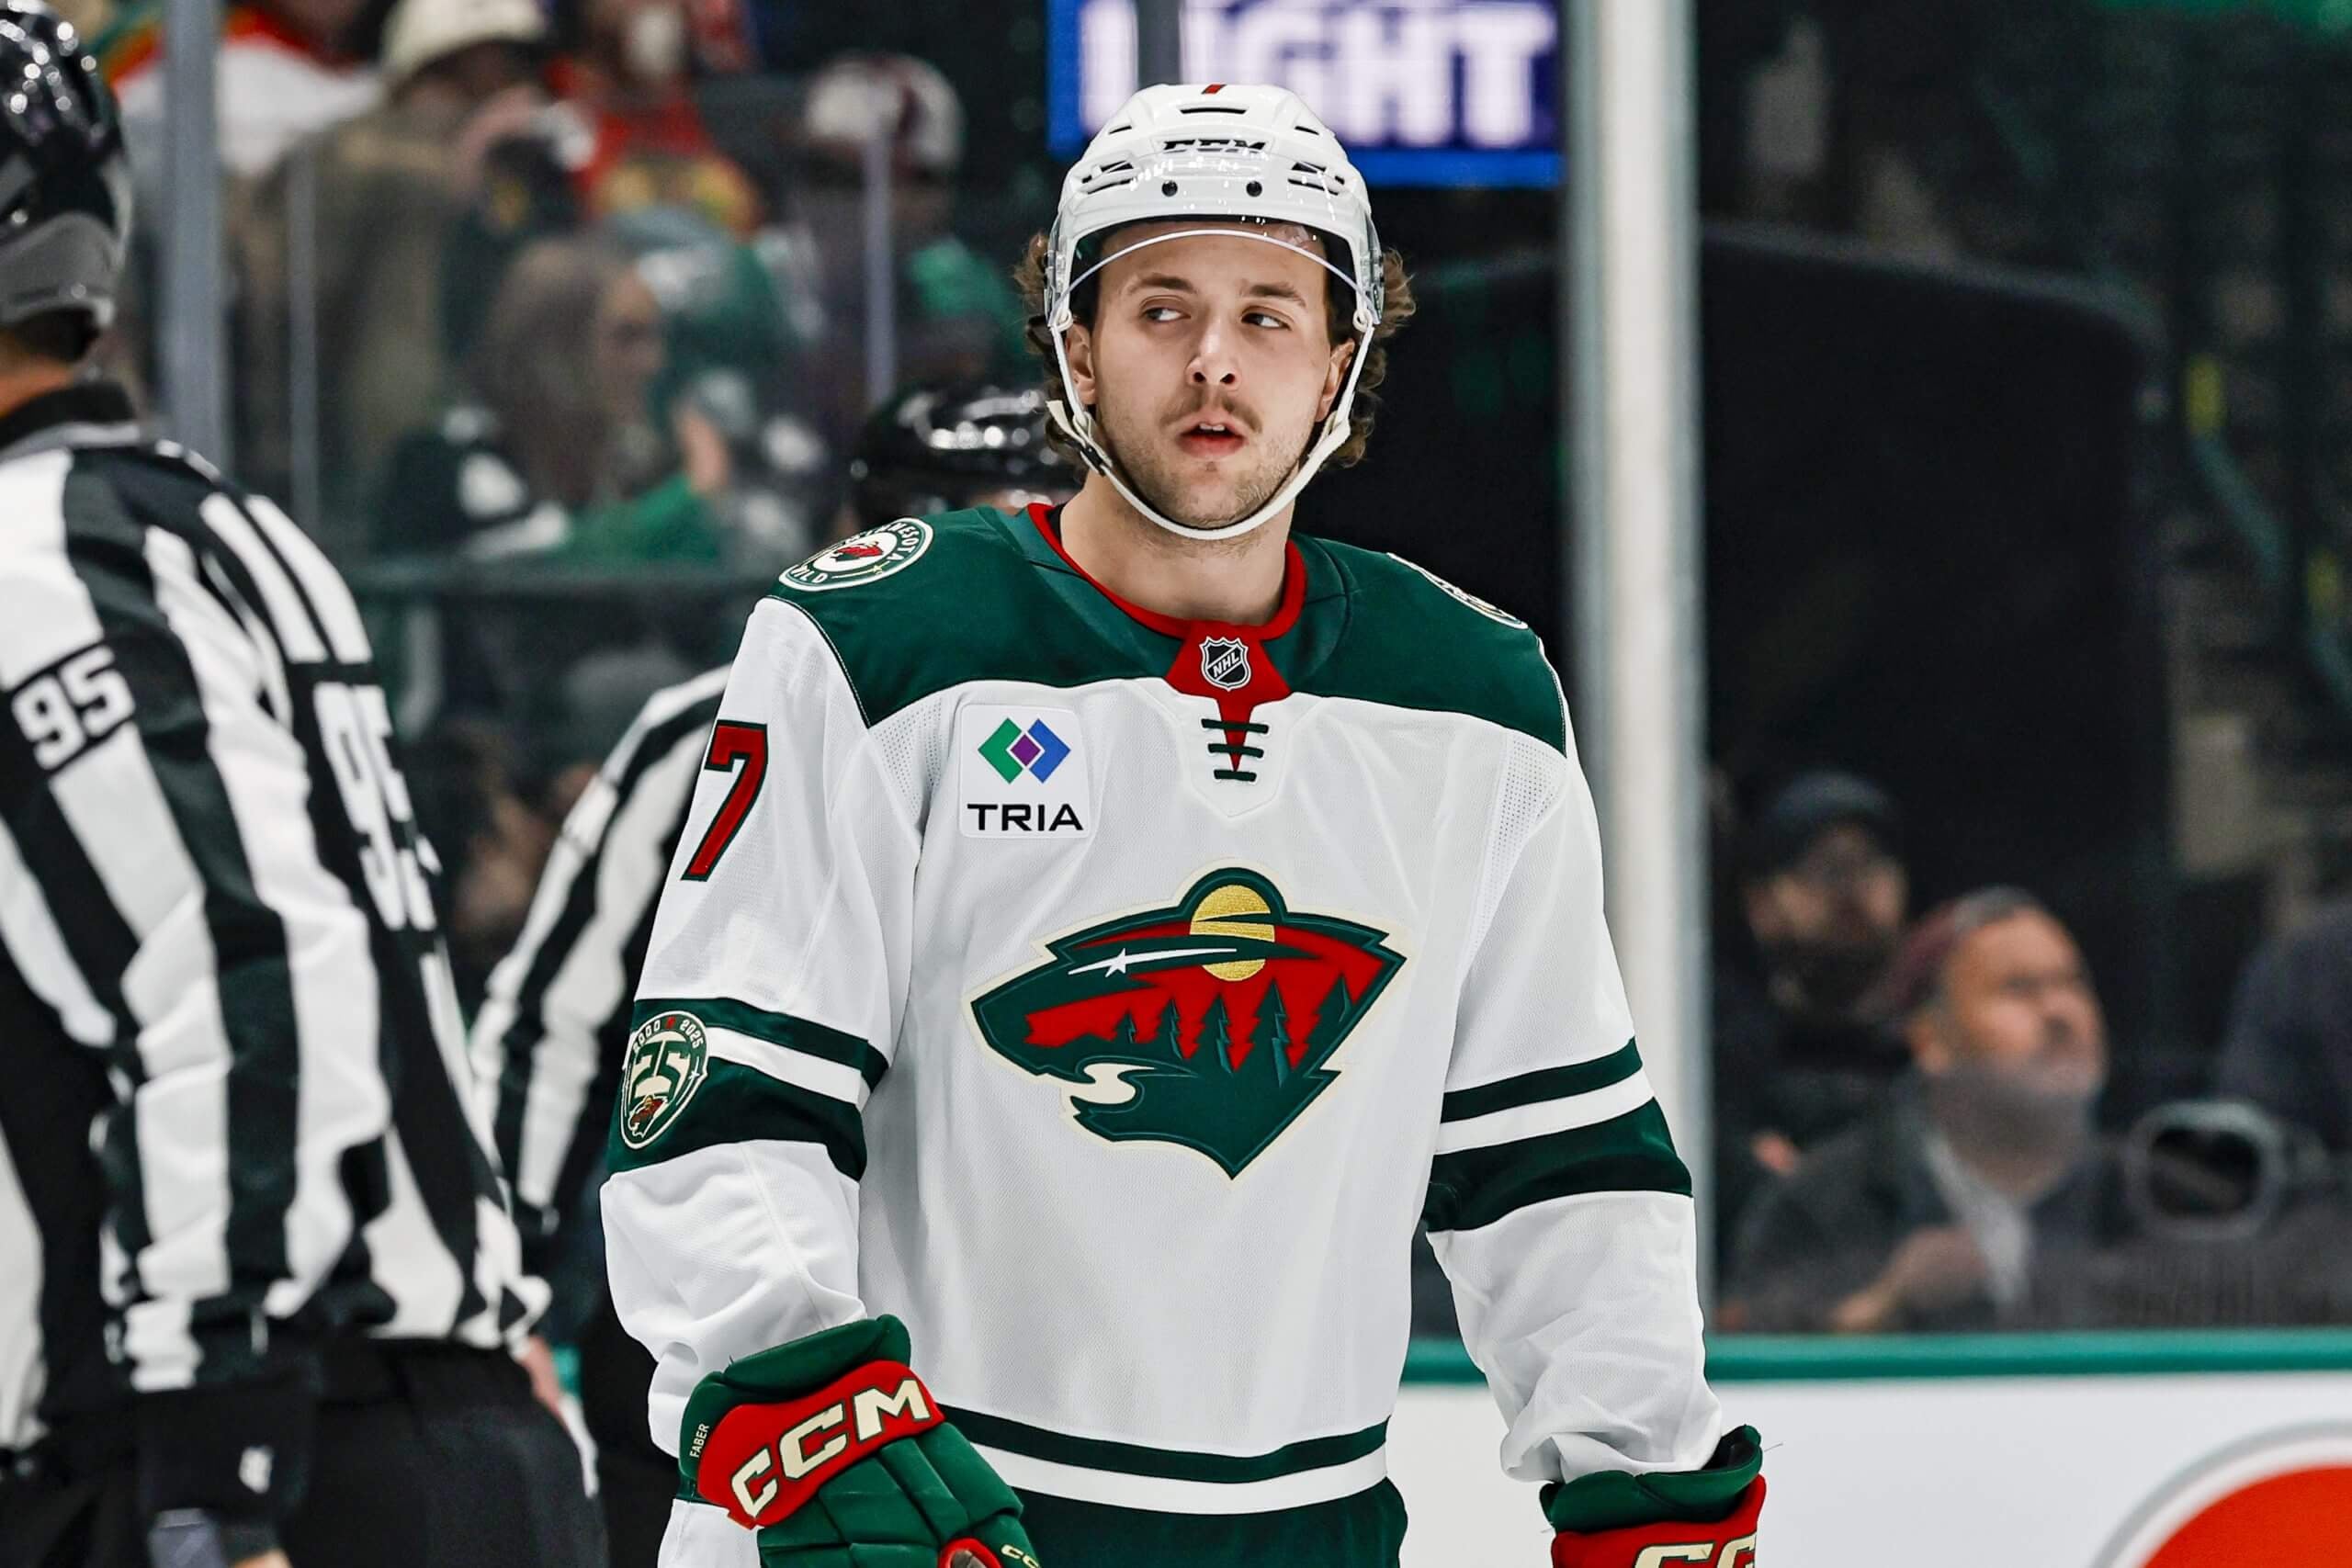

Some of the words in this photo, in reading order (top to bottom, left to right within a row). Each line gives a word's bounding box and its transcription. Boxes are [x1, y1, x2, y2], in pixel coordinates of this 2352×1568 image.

[1213, 651, 1239, 678] NHL
[11, 645, 136, 770] 95
[680, 719, 769, 882] 7
[967, 803, 1084, 831] TRIA
[680, 1019, 704, 1049] 2025
[689, 1423, 710, 1458] FABER
[730, 1378, 931, 1518] CCM
